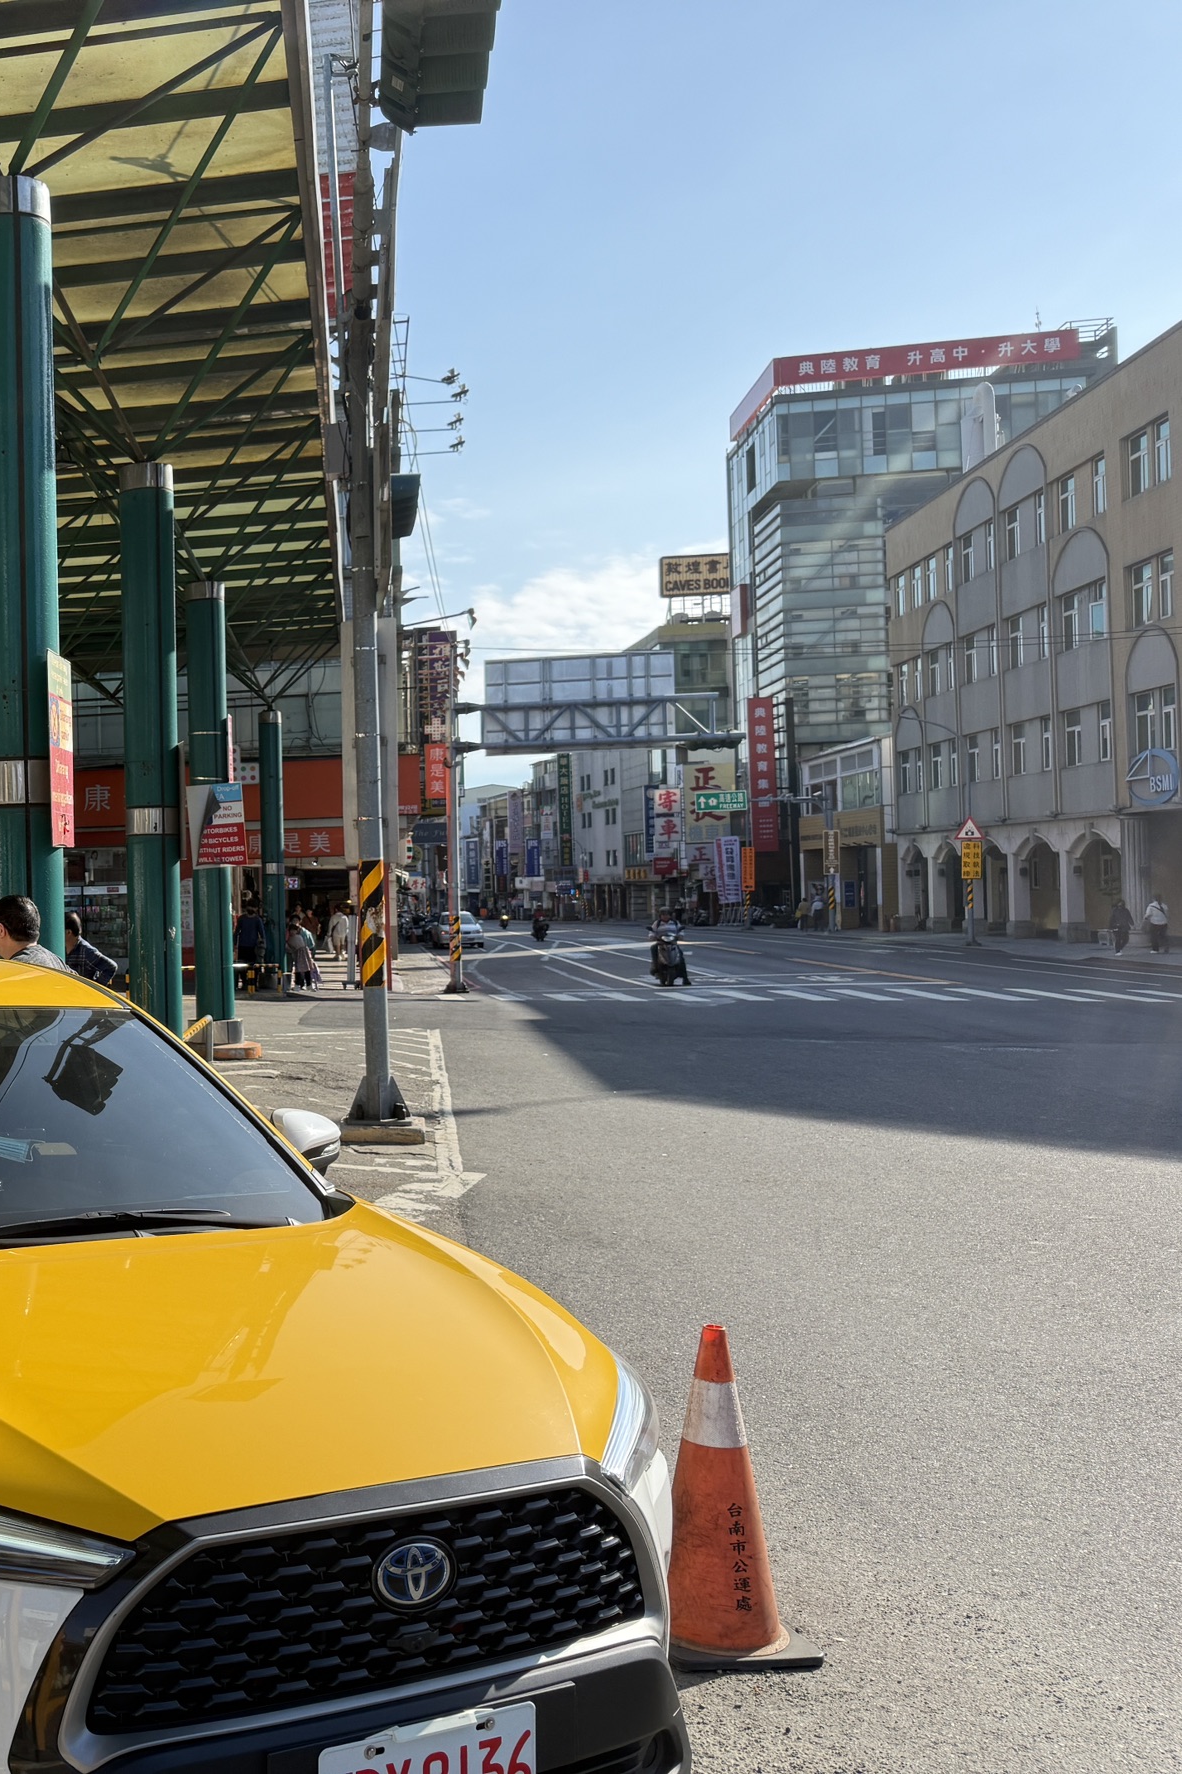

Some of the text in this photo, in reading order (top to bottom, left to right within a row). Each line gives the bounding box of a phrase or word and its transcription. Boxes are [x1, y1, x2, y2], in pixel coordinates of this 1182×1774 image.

[798, 355, 882, 376] 典陸教育
[665, 559, 729, 576] 敦煌書
[665, 577, 729, 591] CAVES BOO
[430, 748, 445, 794] 康是美
[1149, 773, 1173, 793] BSMI
[83, 784, 111, 812] 康
[719, 792, 744, 803] 高速公路
[208, 836, 239, 844] BICYCLES
[727, 1502, 754, 1612] 台南市公運處
